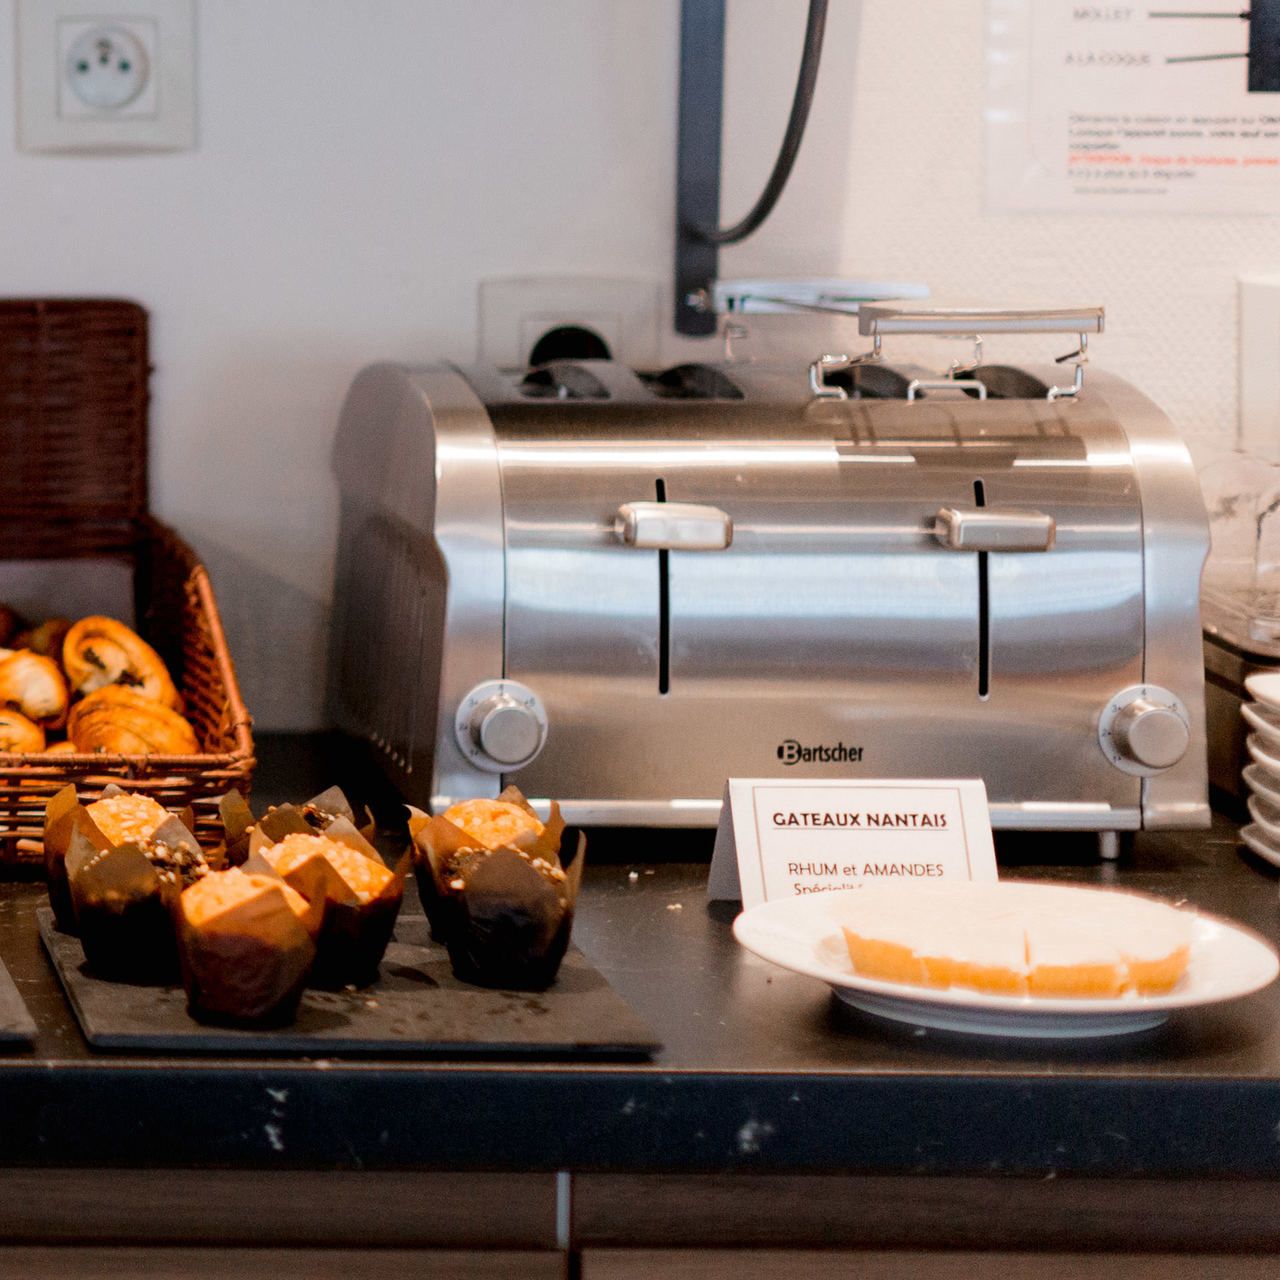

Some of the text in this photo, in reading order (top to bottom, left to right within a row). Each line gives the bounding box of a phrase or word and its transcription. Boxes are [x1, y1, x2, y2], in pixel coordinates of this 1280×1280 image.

[777, 739, 864, 766] Bartscher
[772, 812, 948, 828] GATEAUX NANTAIS
[788, 863, 944, 877] RHUM et AMANDES
